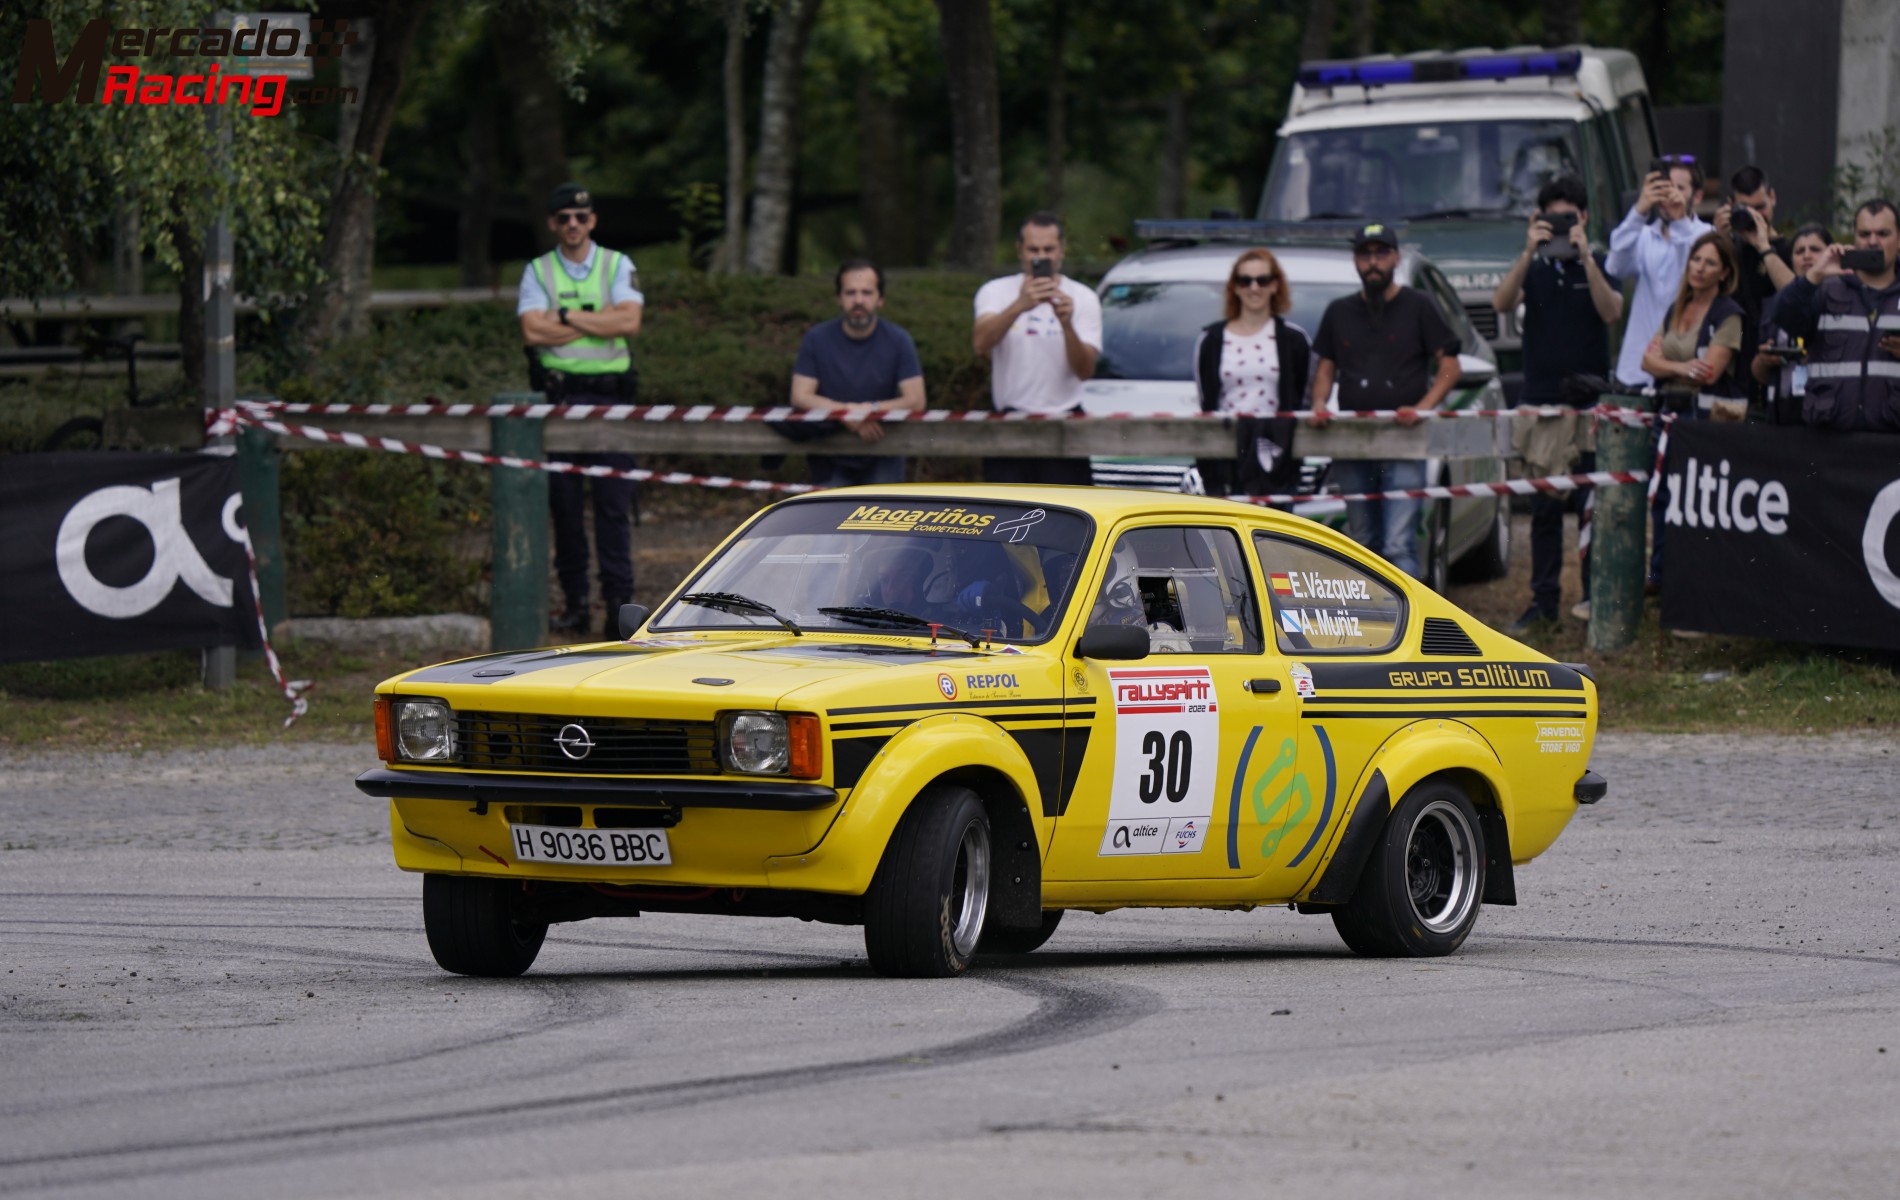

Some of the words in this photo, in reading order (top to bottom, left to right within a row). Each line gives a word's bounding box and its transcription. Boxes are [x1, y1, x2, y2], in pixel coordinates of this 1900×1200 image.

[849, 505, 996, 527] Magariños
[913, 524, 984, 535] COMPETICIÓN
[966, 673, 1019, 689] REPSOL
[1389, 671, 1453, 687] GRUPO
[1188, 704, 1206, 713] 2022
[1540, 743, 1563, 752] STORE
[1565, 743, 1580, 752] VIGO
[1139, 730, 1193, 804] 30
[1133, 825, 1158, 837] altice
[1175, 830, 1197, 839] FUCHS
[516, 829, 535, 857] H
[540, 831, 606, 860] 9036
[610, 834, 664, 862] BBC
